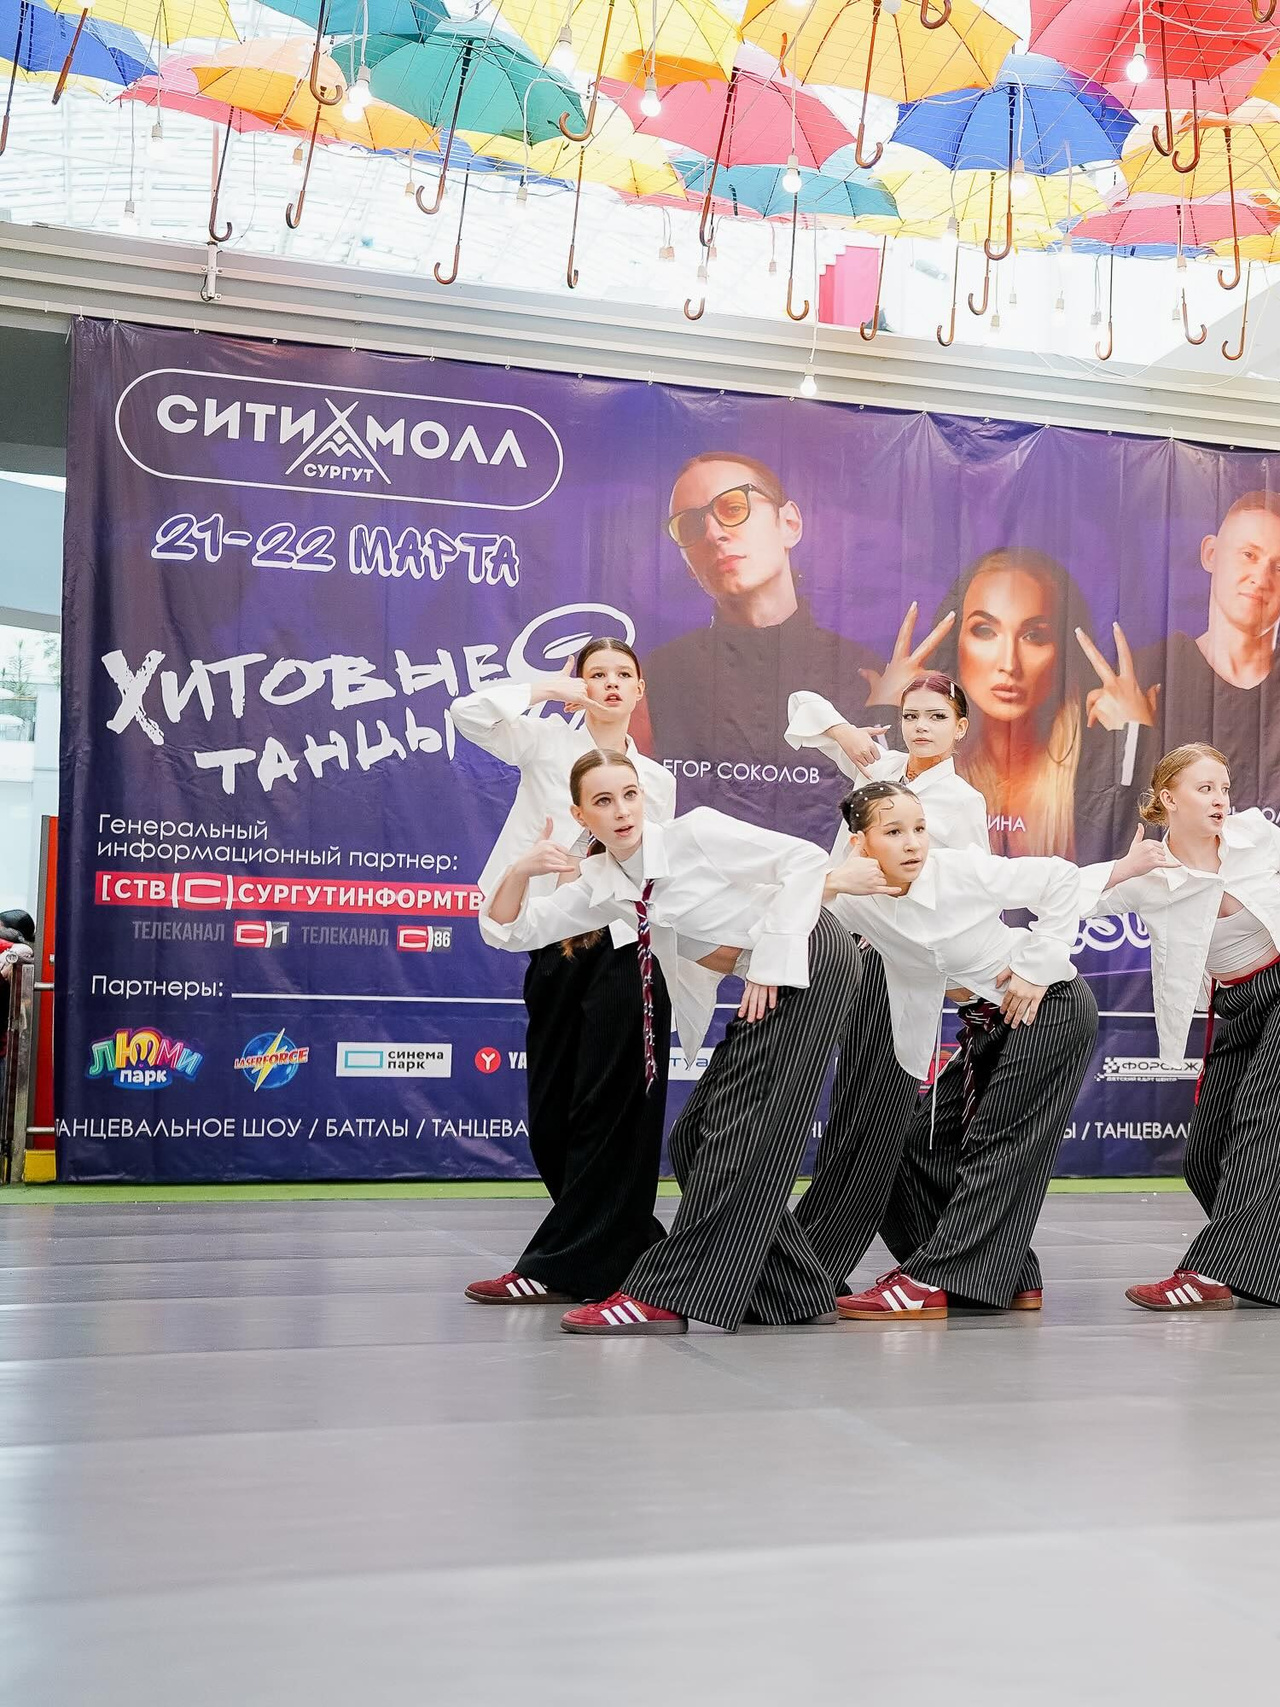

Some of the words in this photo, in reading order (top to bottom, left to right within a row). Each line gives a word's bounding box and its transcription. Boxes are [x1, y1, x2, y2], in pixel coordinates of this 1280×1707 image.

[156, 394, 315, 440] СИТИ
[366, 414, 528, 468] МОЛЛ
[303, 463, 374, 483] СУРГУТ
[151, 513, 336, 573] 21-22
[348, 524, 519, 587] МАРТА
[102, 645, 504, 746] ХИТОВЫЕ
[194, 706, 457, 796] ТАНЦЫ
[717, 762, 820, 784] СОКОЛОВ
[98, 814, 269, 841] Генеральный
[97, 838, 341, 868] информационный
[349, 848, 459, 874] партнер:
[237, 881, 484, 912] СУРГУТИНФОРМТВ
[132, 921, 225, 942] ТЕЛЕКАНАЛ
[301, 926, 389, 947] ТЕЛЕКАНАЛ
[91, 975, 224, 1000] Партнеры:
[89, 1031, 202, 1077] ЛЮМИ
[234, 1047, 309, 1070] LASERFORCE
[388, 1061, 425, 1072] парк
[508, 1051, 528, 1070] YA
[1122, 1062, 1198, 1071] ФОРСЖ
[120, 1069, 167, 1087] парк
[242, 1118, 302, 1138] ШОУ
[326, 1119, 408, 1138] БАТТЛЫ
[432, 1118, 529, 1141] ТАНЦЕВА
[1094, 1121, 1191, 1140] ТАНЦЕВАЛ
